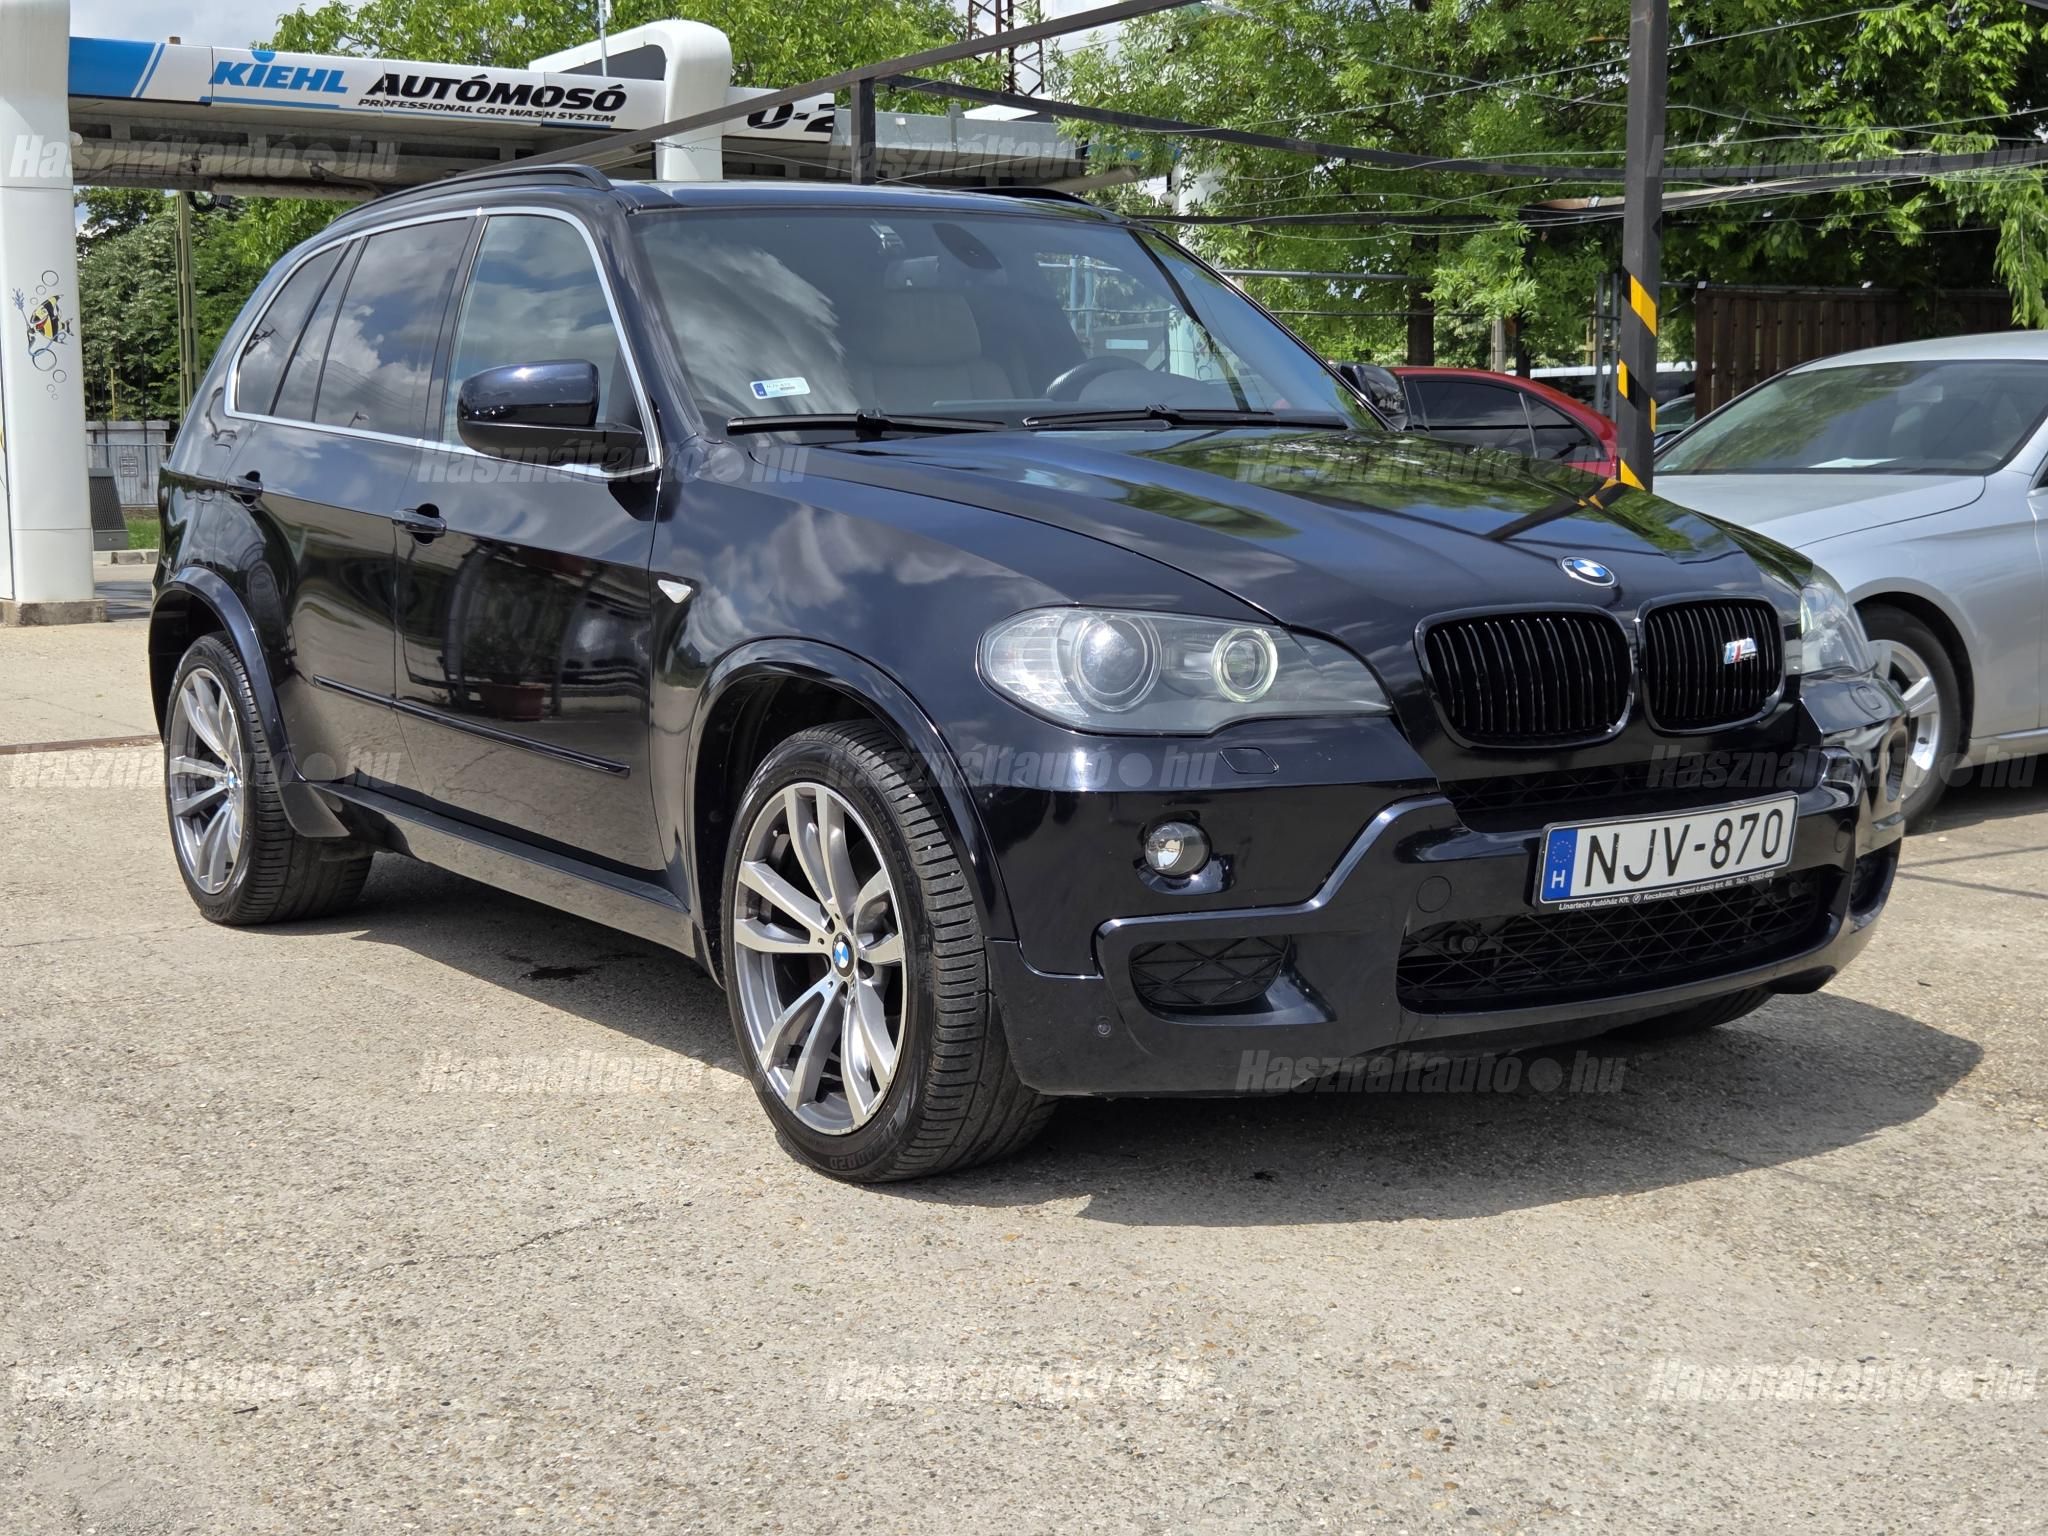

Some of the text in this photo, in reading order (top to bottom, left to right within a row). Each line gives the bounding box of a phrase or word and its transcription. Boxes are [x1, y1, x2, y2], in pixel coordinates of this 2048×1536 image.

[208, 52, 348, 94] KIEHL
[365, 73, 627, 112] AUTÓMOSÓ
[358, 99, 617, 123] PROFESSIONAL CAR WASH SYSTEM
[1584, 808, 1783, 888] NJV-870
[1551, 869, 1566, 889] H
